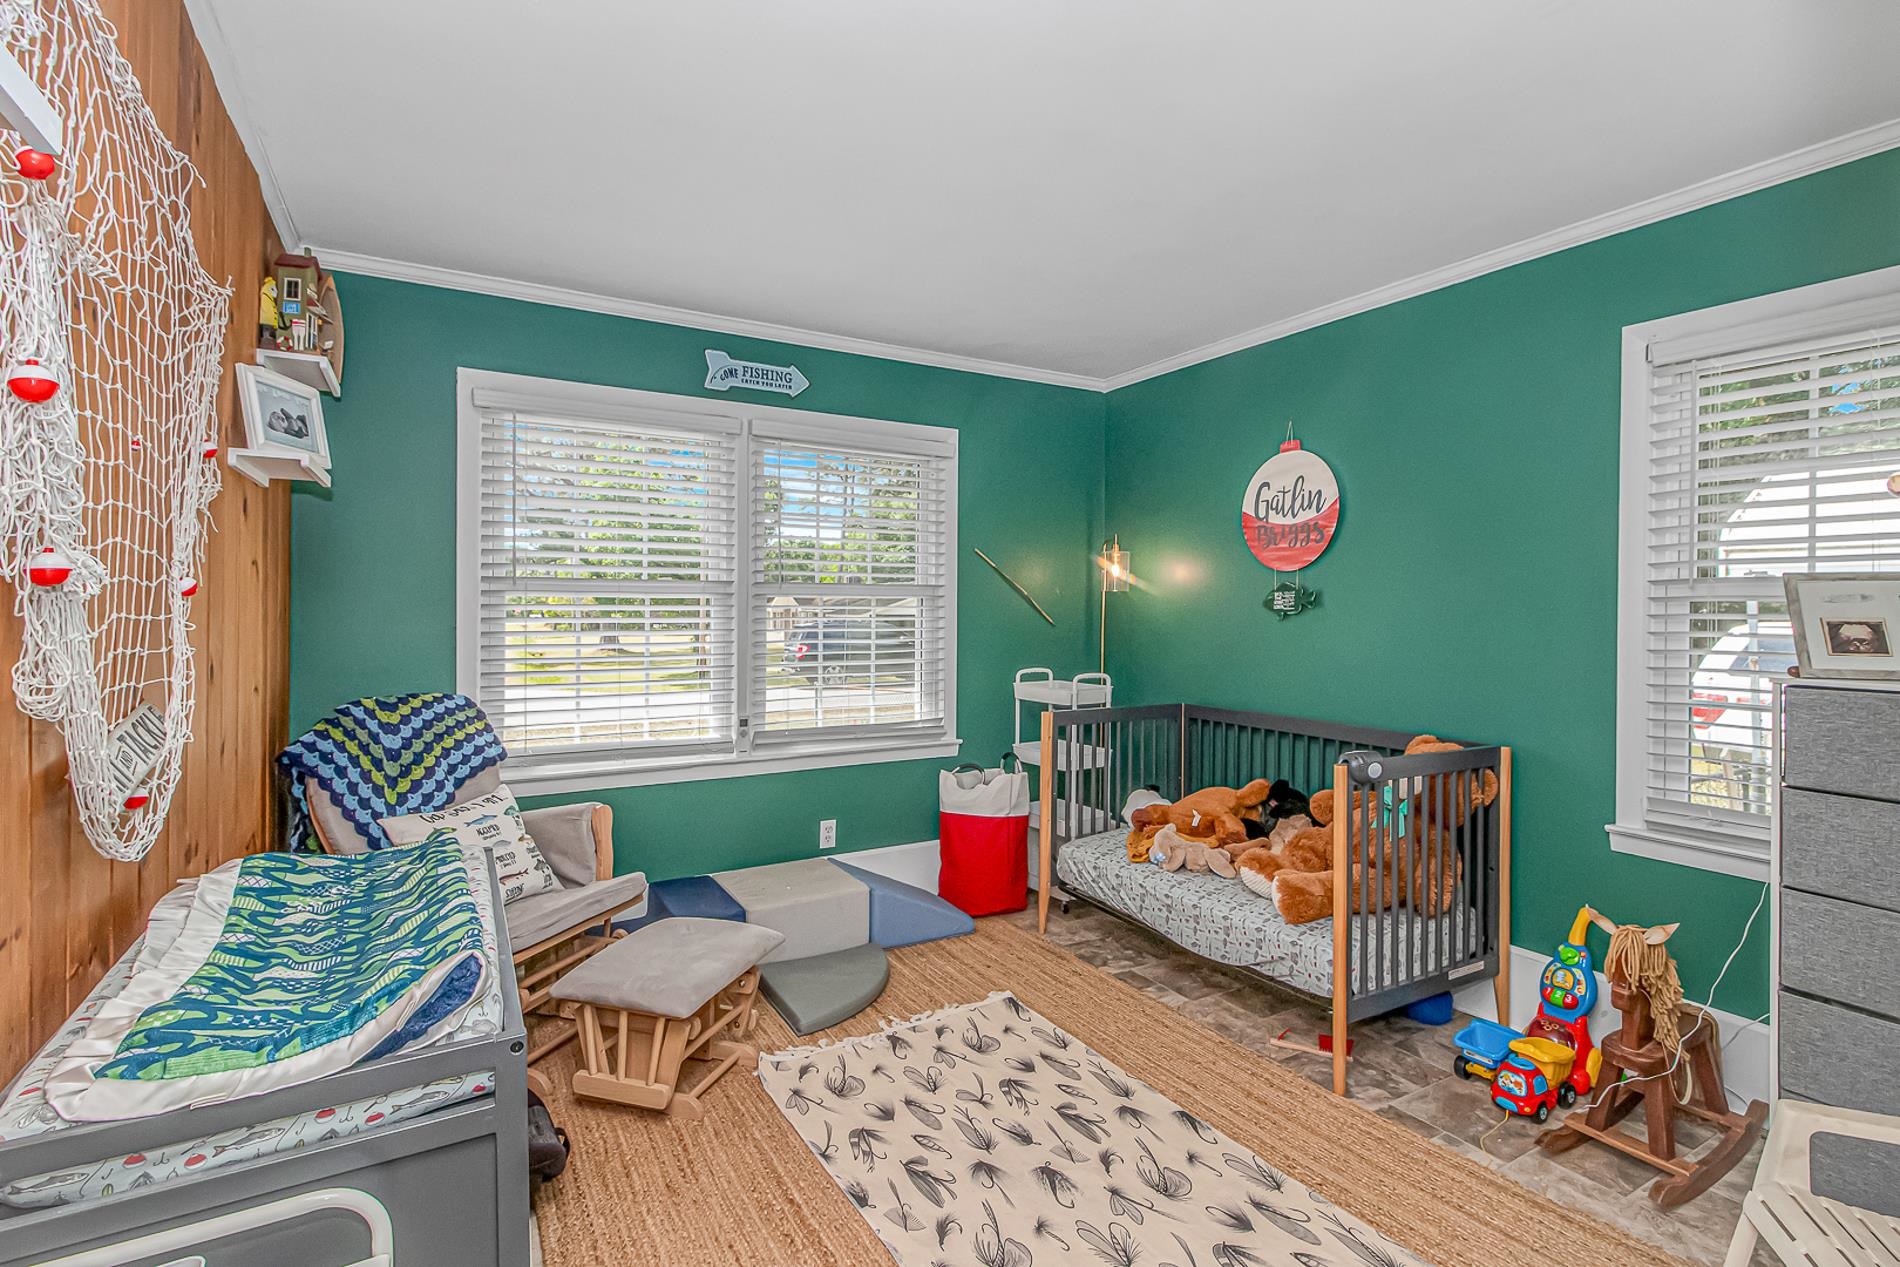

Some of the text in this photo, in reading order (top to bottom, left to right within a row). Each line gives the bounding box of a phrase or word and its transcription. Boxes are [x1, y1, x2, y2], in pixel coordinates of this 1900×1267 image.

[742, 366, 792, 383] FISHING
[1254, 475, 1327, 523] Gatlin
[1555, 990, 1562, 998] 2
[1564, 994, 1572, 1003] 3
